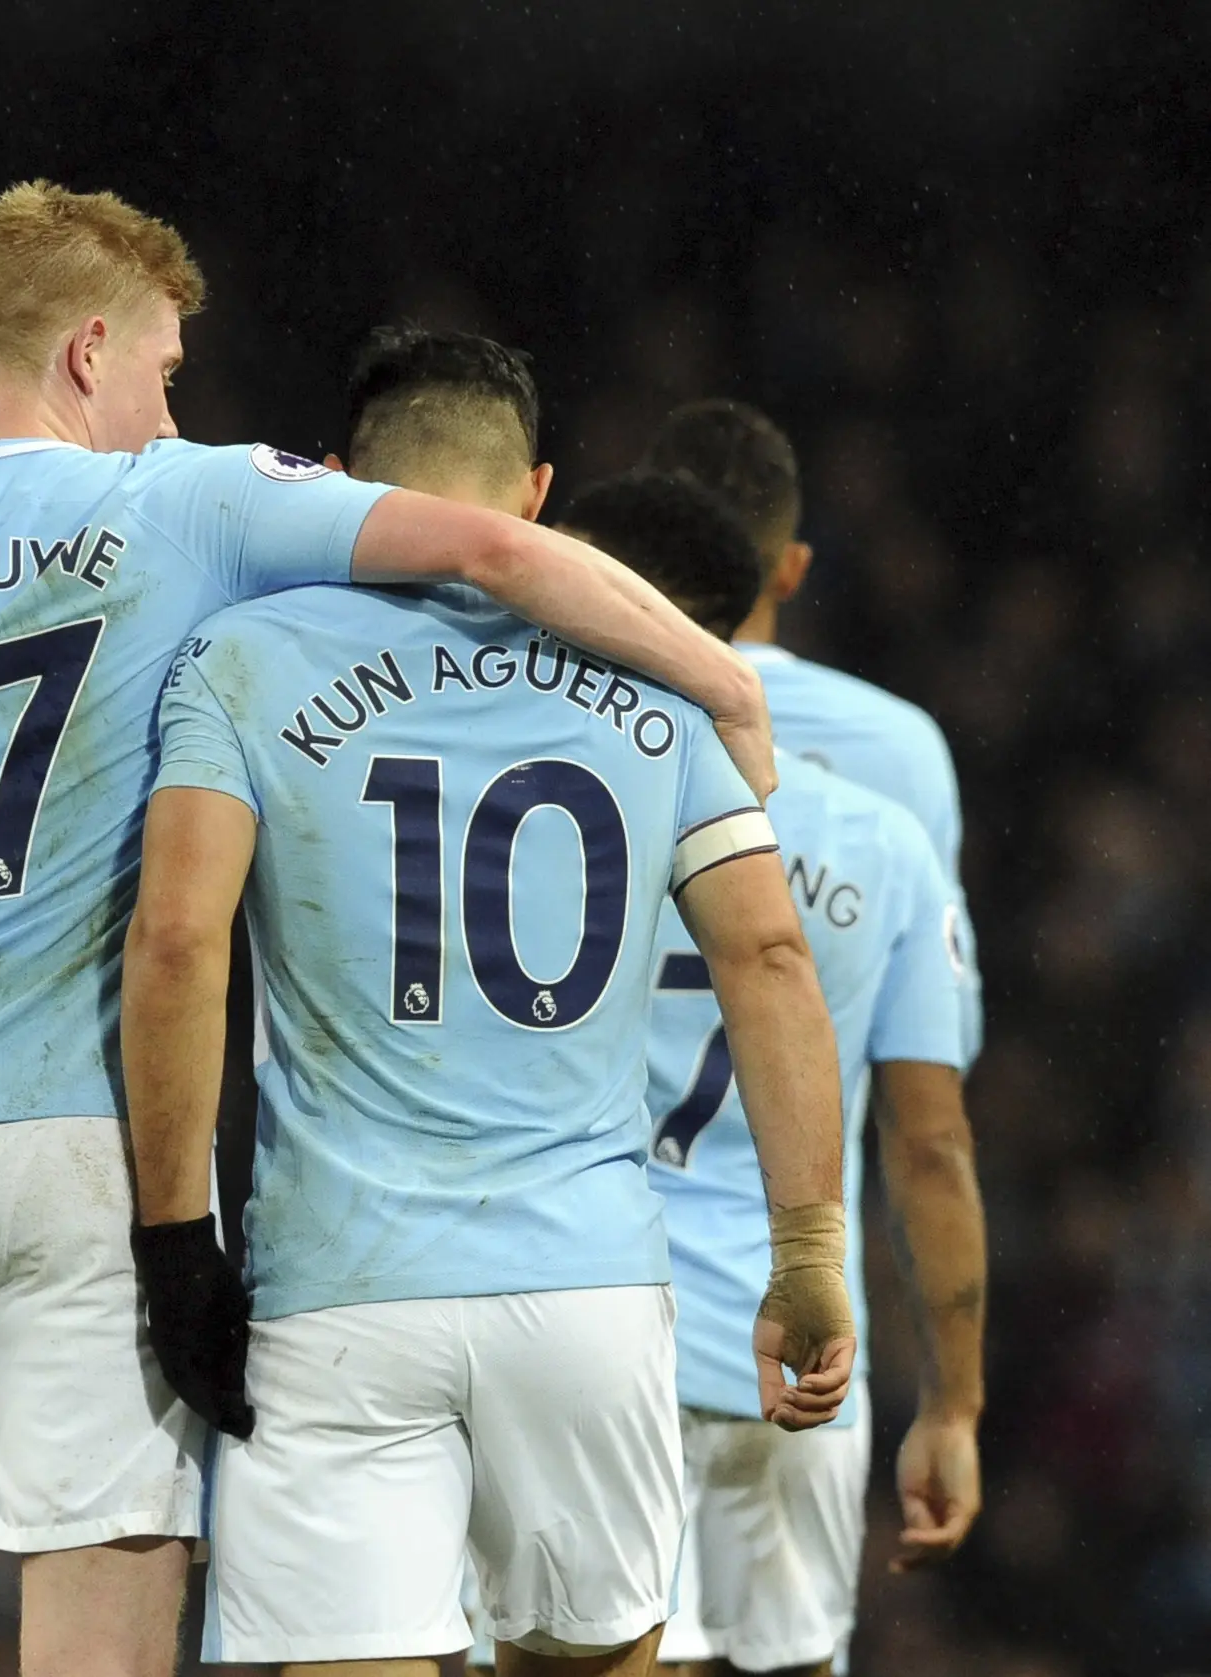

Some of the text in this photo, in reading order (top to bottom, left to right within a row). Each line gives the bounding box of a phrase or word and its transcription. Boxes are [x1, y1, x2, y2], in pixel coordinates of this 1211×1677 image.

[279, 628, 677, 770] KUN AGÜERO
[359, 754, 631, 1033] 10
